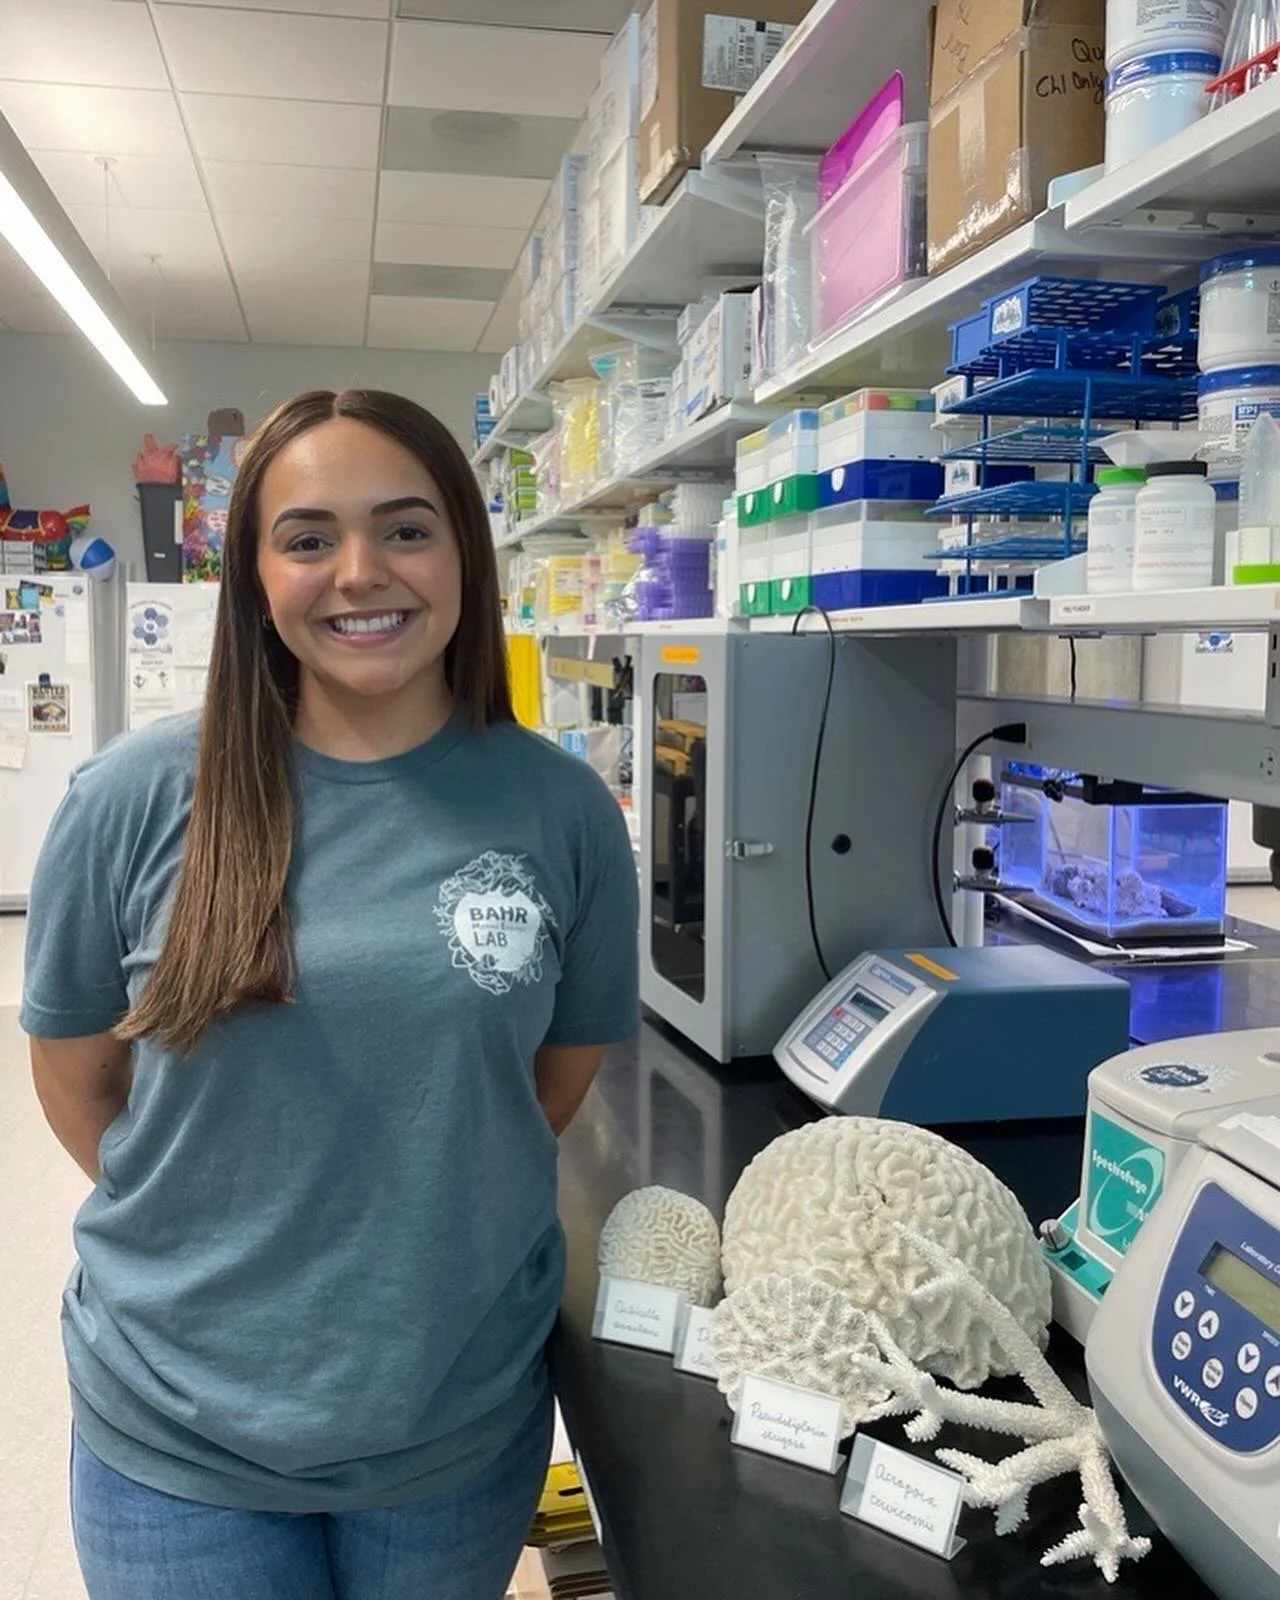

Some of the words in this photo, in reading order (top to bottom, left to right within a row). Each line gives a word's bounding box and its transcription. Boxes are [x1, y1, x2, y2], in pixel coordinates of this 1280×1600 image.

[470, 906, 528, 924] BAHR
[473, 930, 508, 947] LAB
[1173, 1374, 1201, 1408] VWR
